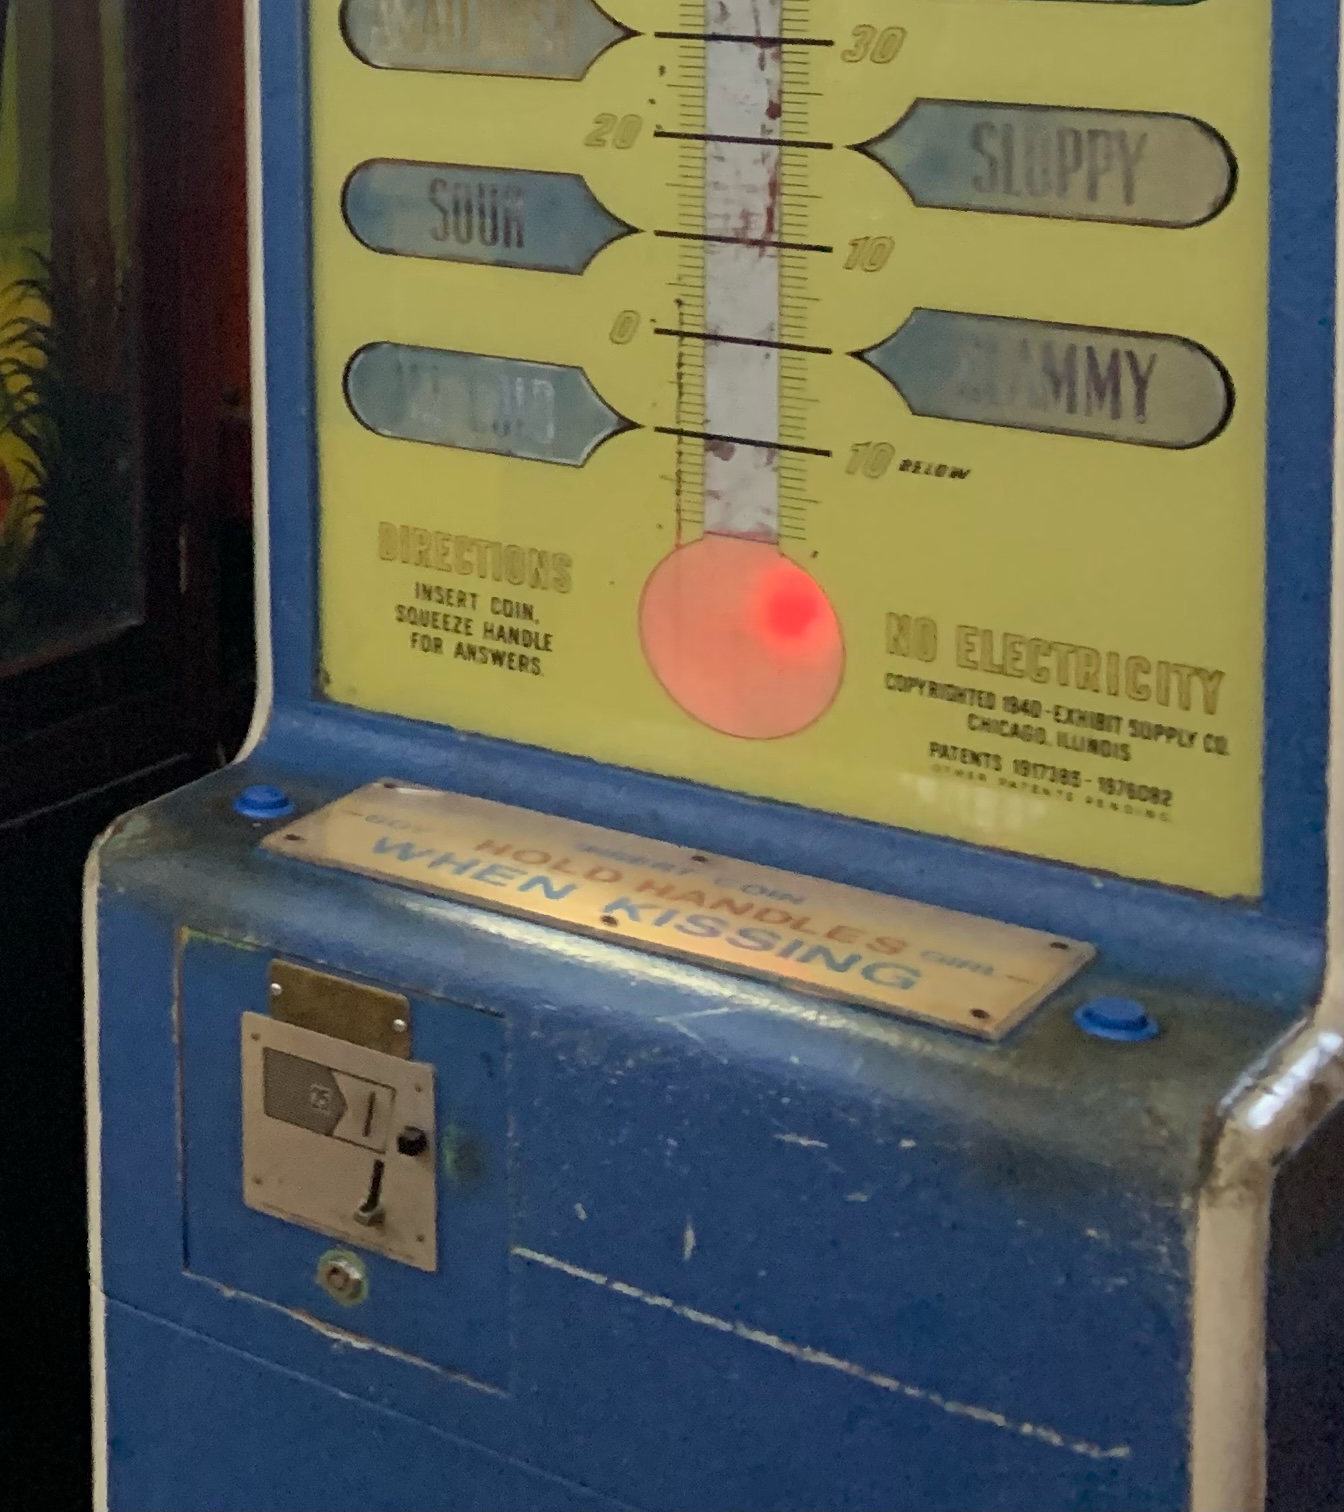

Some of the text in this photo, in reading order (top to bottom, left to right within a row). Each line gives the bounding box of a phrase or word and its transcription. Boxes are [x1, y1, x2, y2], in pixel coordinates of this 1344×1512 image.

[841, 24, 907, 65] 30
[584, 113, 643, 150] 20
[969, 119, 1149, 206] SLOPPY
[428, 177, 526, 250] SOUR
[842, 235, 896, 274] 10
[609, 309, 641, 346] 0
[844, 440, 972, 480] 10 BELOW
[377, 520, 575, 594] DIRECTIONS
[414, 581, 479, 611] INSERT
[395, 603, 554, 653] SQUEEZE HANDLE
[409, 631, 444, 655] FOR
[885, 611, 1227, 716] NO ELECTRICITY
[928, 740, 1003, 772] PATENTS
[372, 835, 923, 991] WHEN KISSING
[473, 838, 909, 956] HOLD HANDLES
